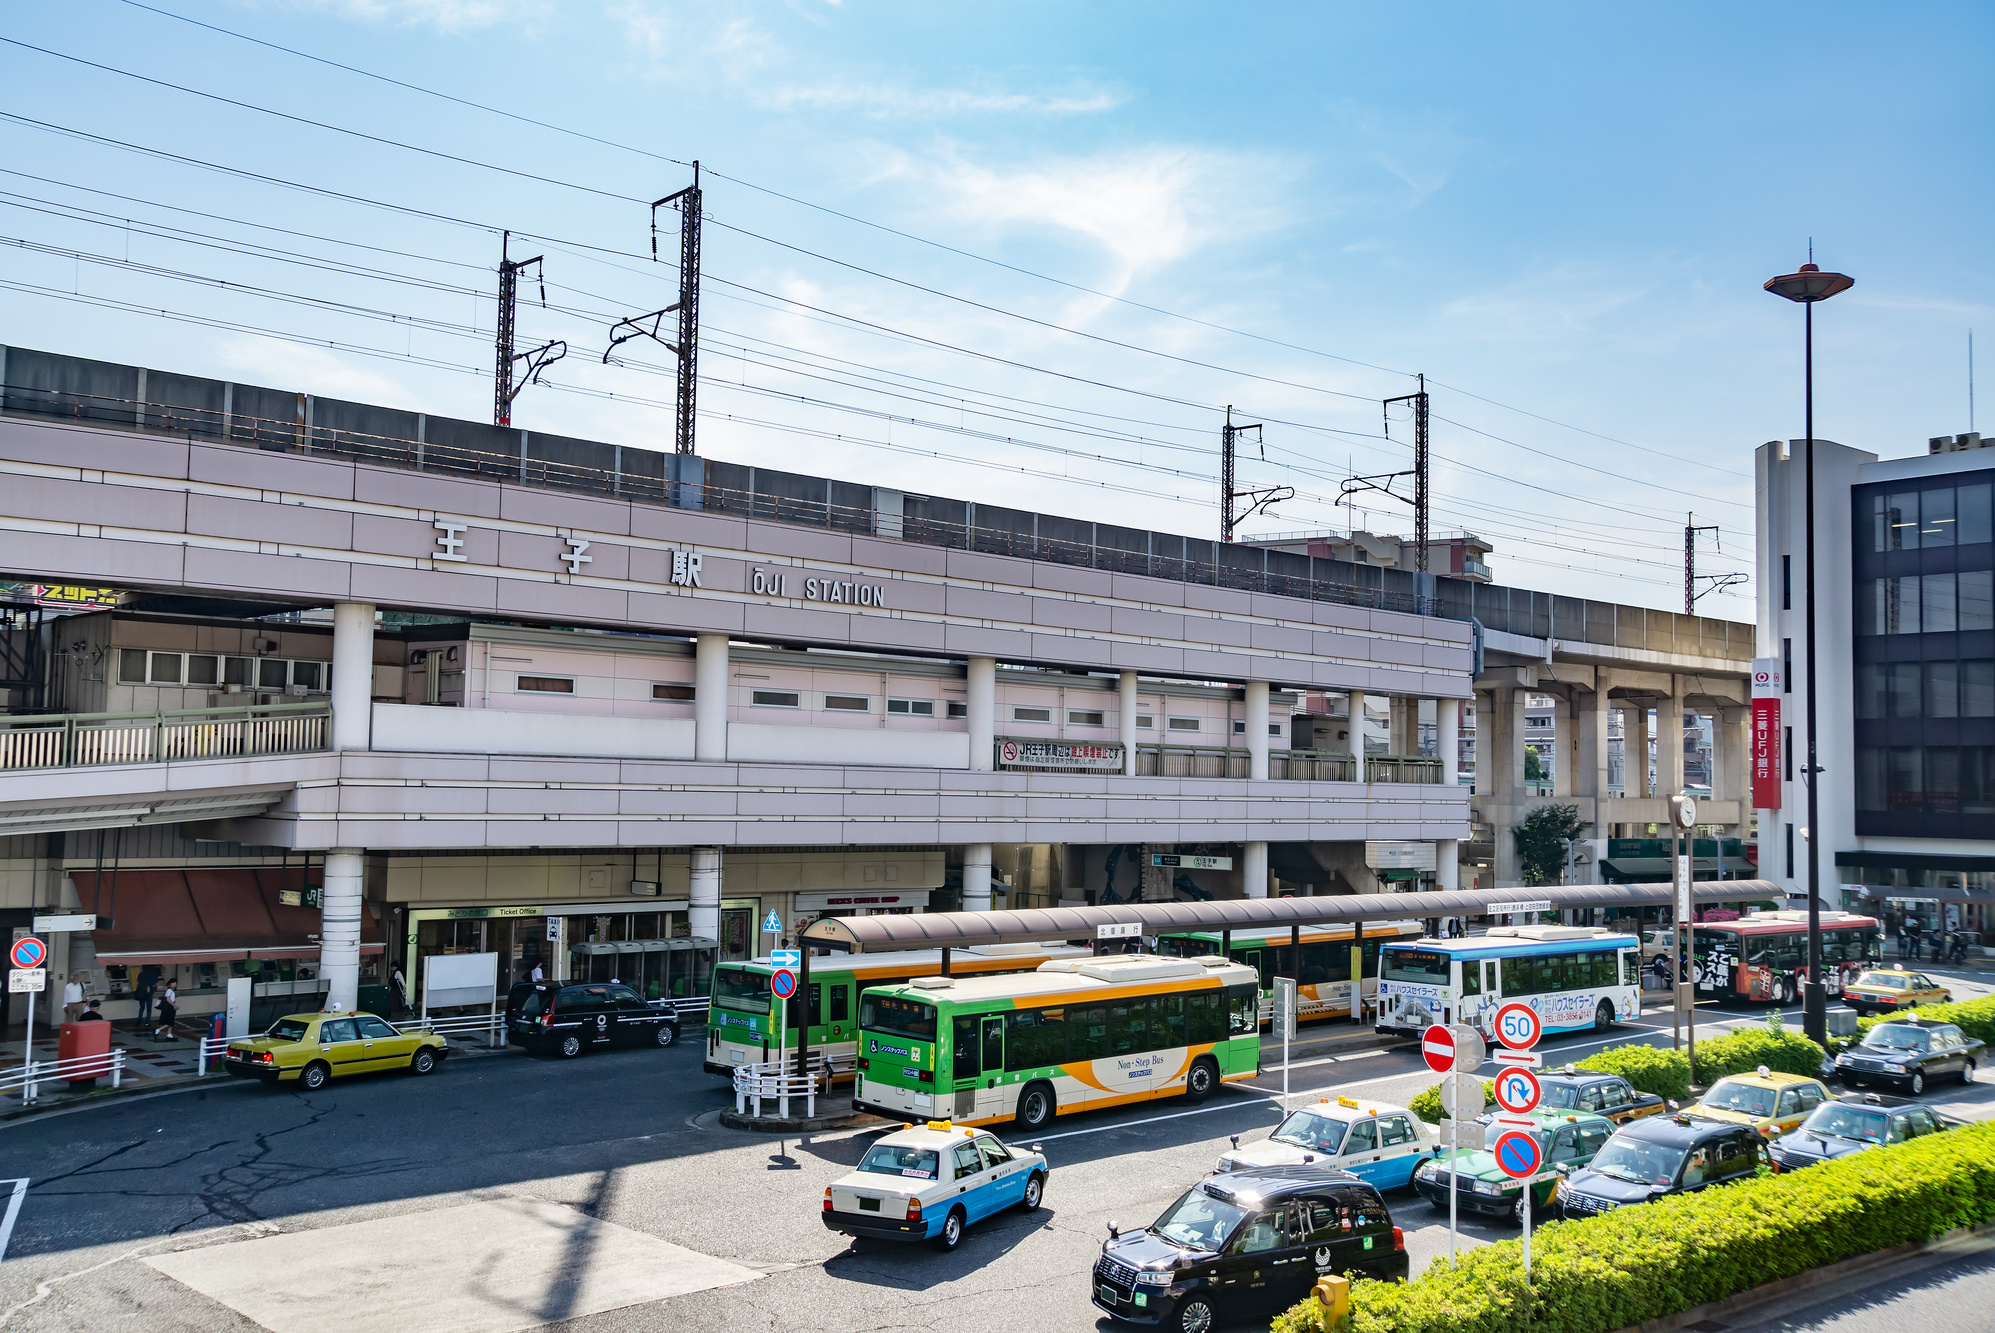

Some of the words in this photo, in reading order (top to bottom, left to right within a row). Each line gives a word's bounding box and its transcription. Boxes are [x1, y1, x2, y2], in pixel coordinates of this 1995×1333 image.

[432, 522, 702, 588] 王子駅
[753, 567, 785, 597] ŌJI
[805, 577, 885, 608] STATION
[1757, 709, 1768, 778] 三菱UFJ銀行
[306, 889, 317, 901] JR
[500, 908, 518, 916] Ticket
[1396, 985, 1438, 997] ハウスセイラーズ
[1551, 994, 1595, 1012] ハウスセイラーズ
[1505, 1016, 1530, 1037] 50
[881, 1045, 908, 1056] ノンステップバス
[1152, 1055, 1164, 1065] Bus
